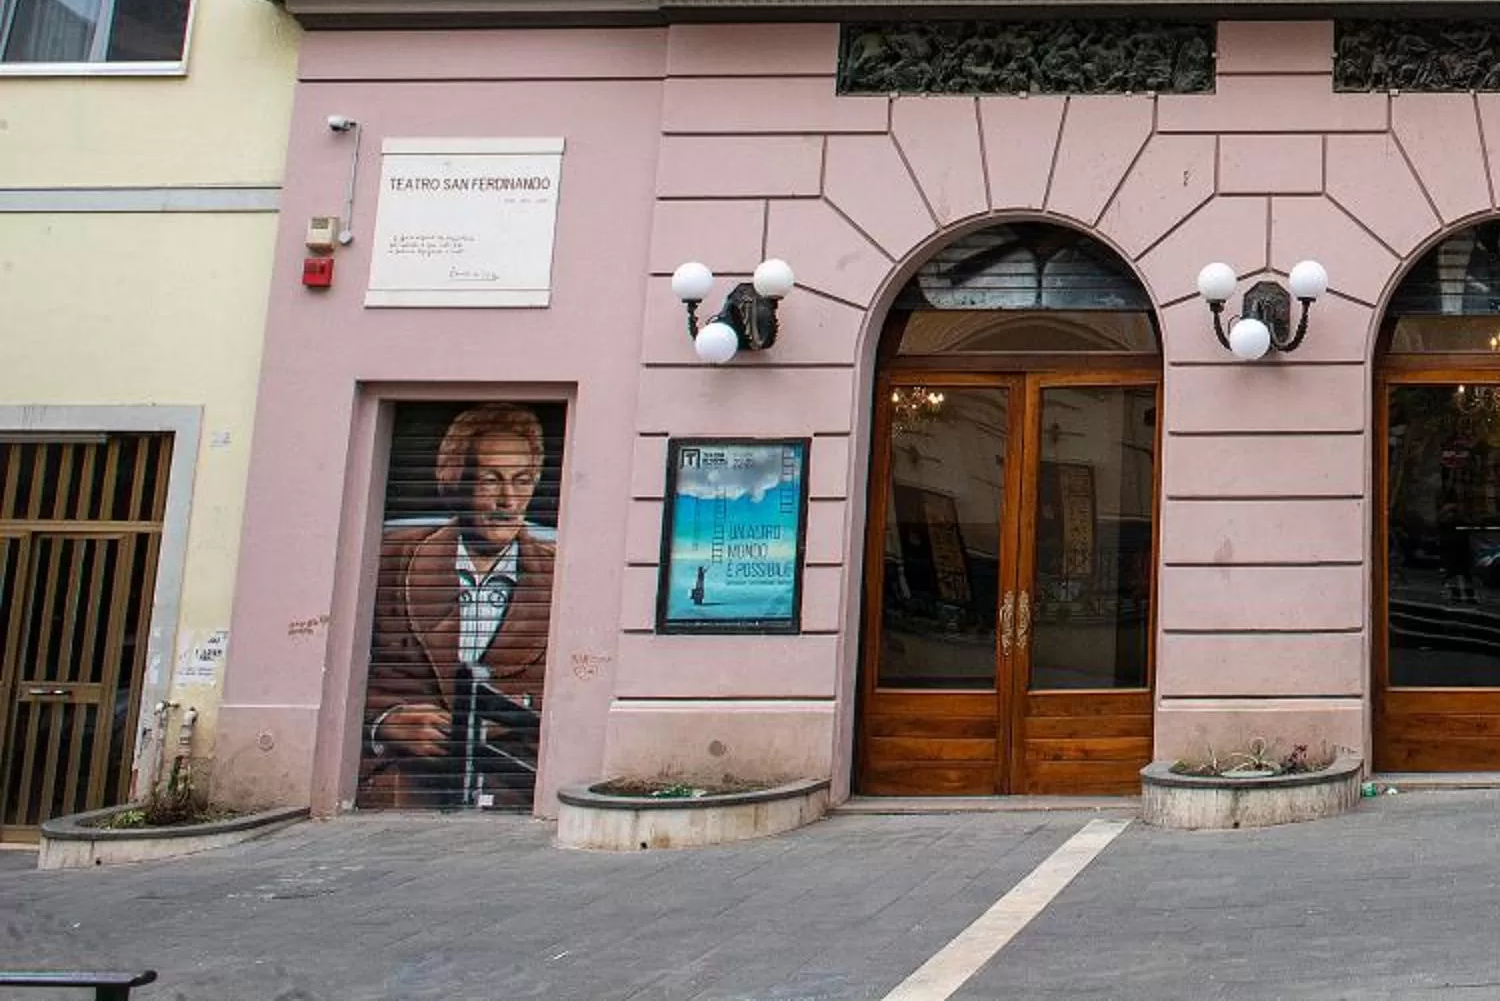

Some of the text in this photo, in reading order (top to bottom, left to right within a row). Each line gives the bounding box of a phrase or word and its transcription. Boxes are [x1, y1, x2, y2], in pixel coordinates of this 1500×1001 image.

[390, 176, 551, 191] TEATRO SAN FERDINANDO
[727, 542, 768, 559] MONDO
